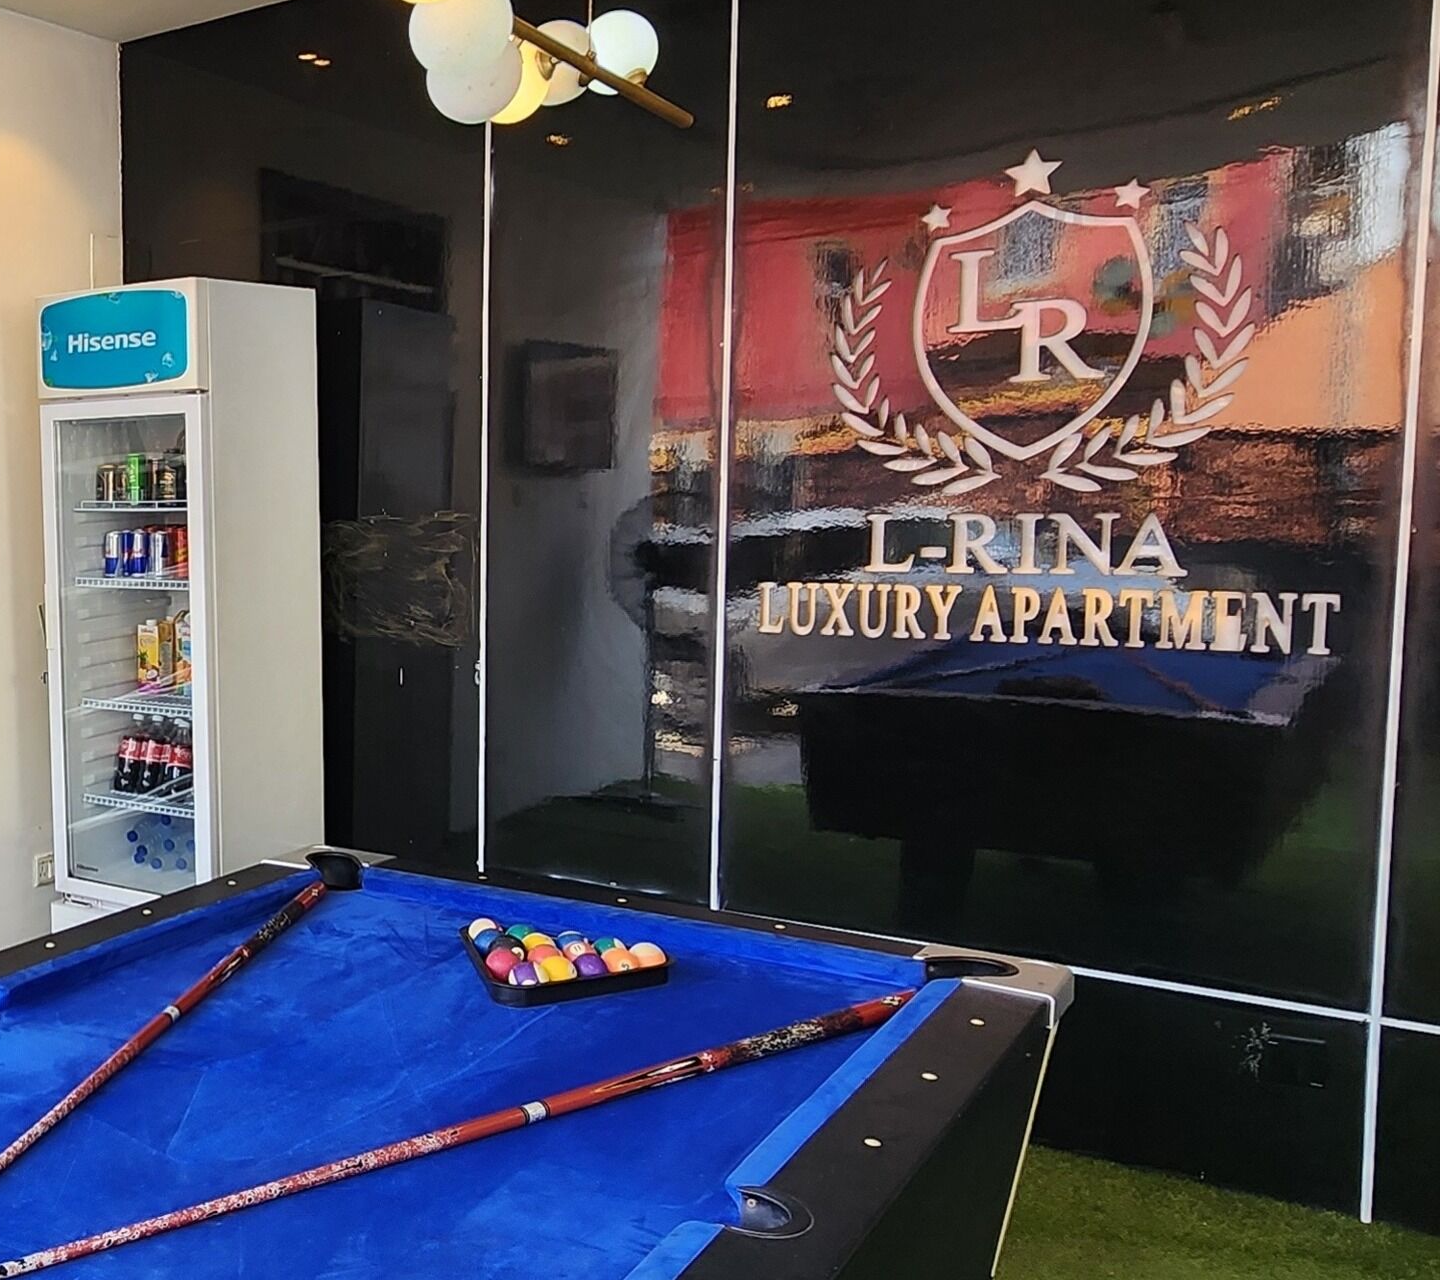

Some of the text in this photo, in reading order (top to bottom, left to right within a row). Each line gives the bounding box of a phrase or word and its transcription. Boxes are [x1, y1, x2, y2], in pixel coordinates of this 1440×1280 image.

[67, 331, 157, 354] Hisense
[864, 512, 1188, 577] L-RINA
[758, 581, 1341, 656] LUXURY APARTMENT
